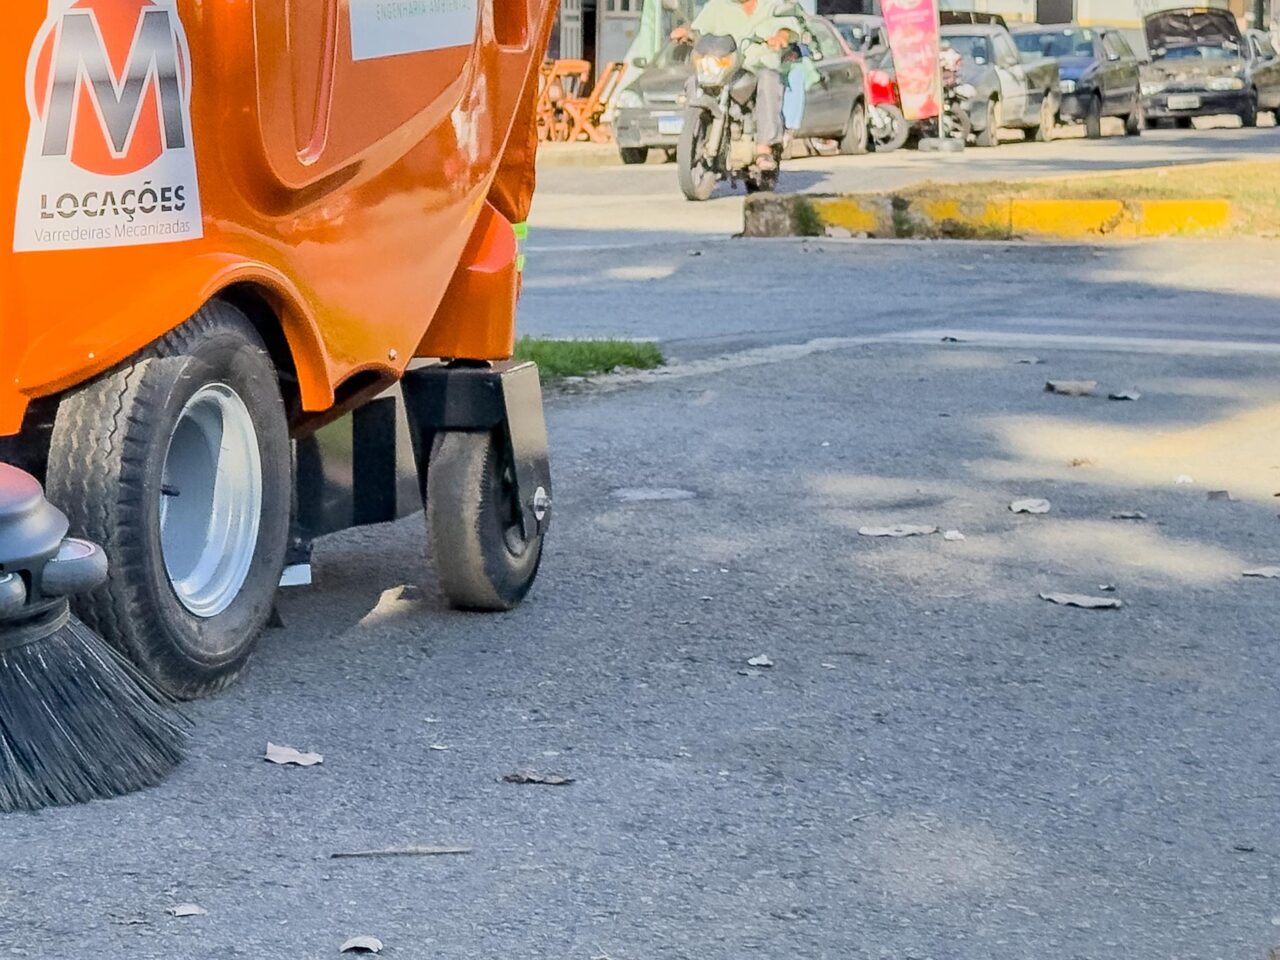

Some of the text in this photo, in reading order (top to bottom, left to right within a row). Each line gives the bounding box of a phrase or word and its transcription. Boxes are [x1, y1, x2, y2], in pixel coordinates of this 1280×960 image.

[40, 180, 186, 223] LOCAÇÕES
[34, 218, 191, 243] Varredeiras Mecanizadas
